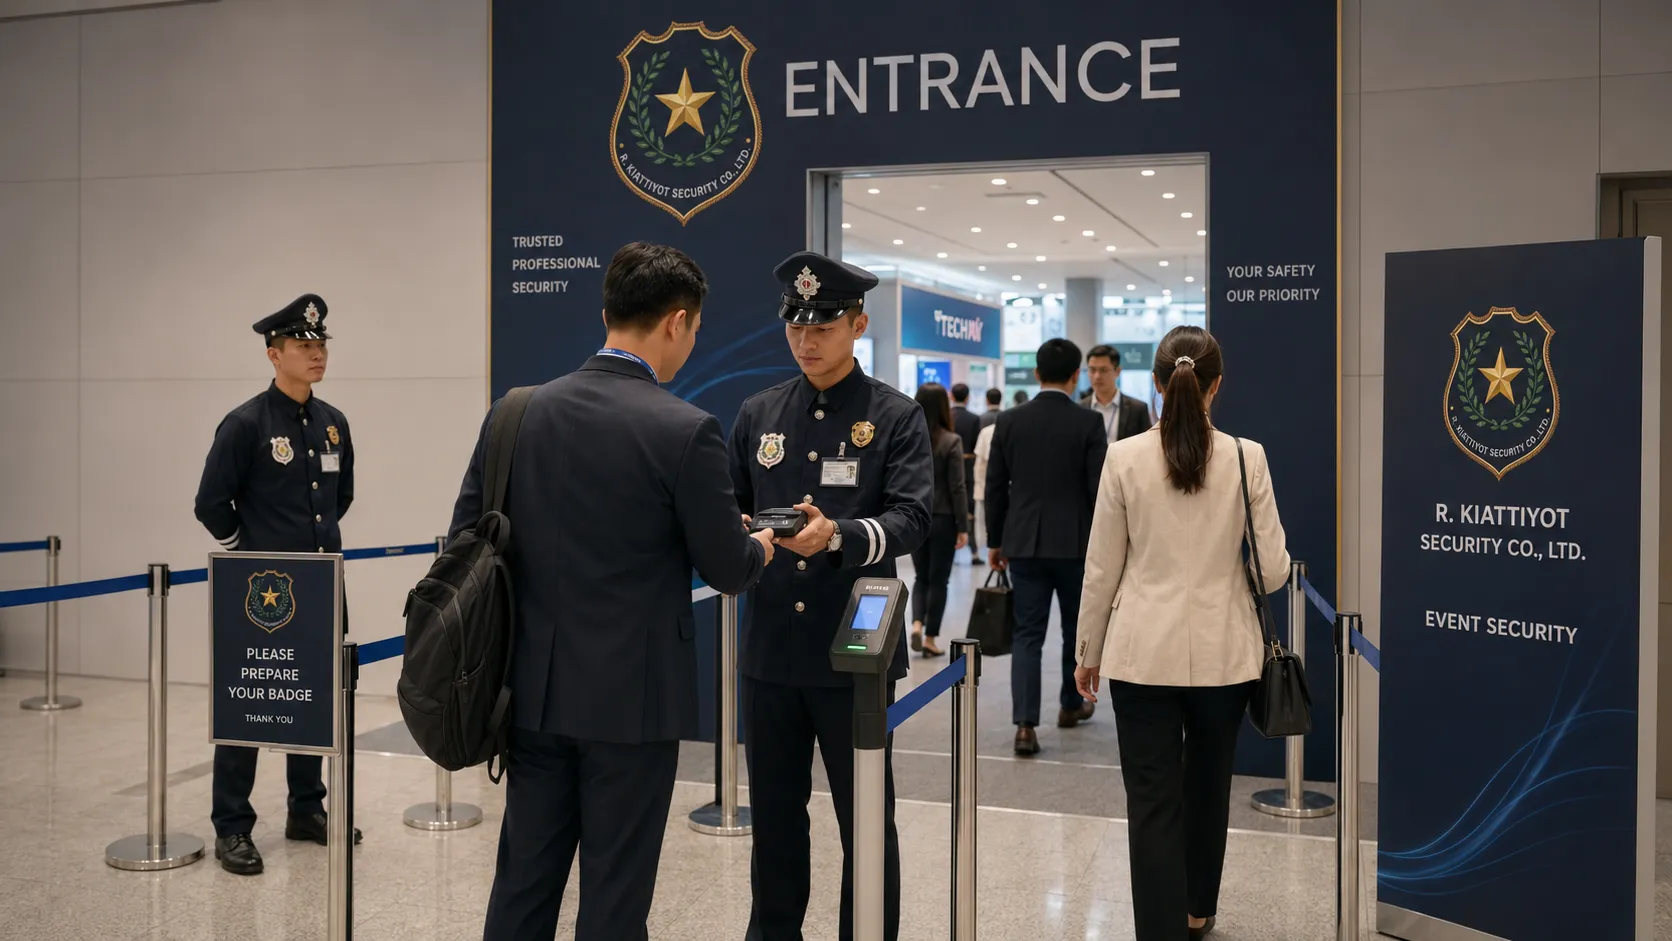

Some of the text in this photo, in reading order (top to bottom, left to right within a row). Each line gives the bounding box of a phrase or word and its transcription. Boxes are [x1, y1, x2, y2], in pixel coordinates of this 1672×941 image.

[785, 37, 1181, 118] ENTRANCE
[619, 147, 751, 199] R. KIATTIYOT SECURITY CO., LTD.
[512, 235, 563, 248] TRUSTED
[512, 256, 601, 271] PROFESSIONAL
[1226, 264, 1316, 278] YOUR SAFETY
[512, 280, 569, 294] SECURITY
[1226, 288, 1320, 302] OUR PRIORITY
[1489, 443, 1525, 458] SECURITY
[1435, 503, 1570, 529] R. KIATTIYOT
[1420, 533, 1586, 561] SECURITY CO., LTD.
[1425, 610, 1578, 645] EVENT SECURITY
[246, 647, 294, 660] PLEASE
[241, 667, 299, 681] PREPARE
[228, 686, 312, 701] YOUR BADGE
[245, 714, 294, 724] THANK YOU
